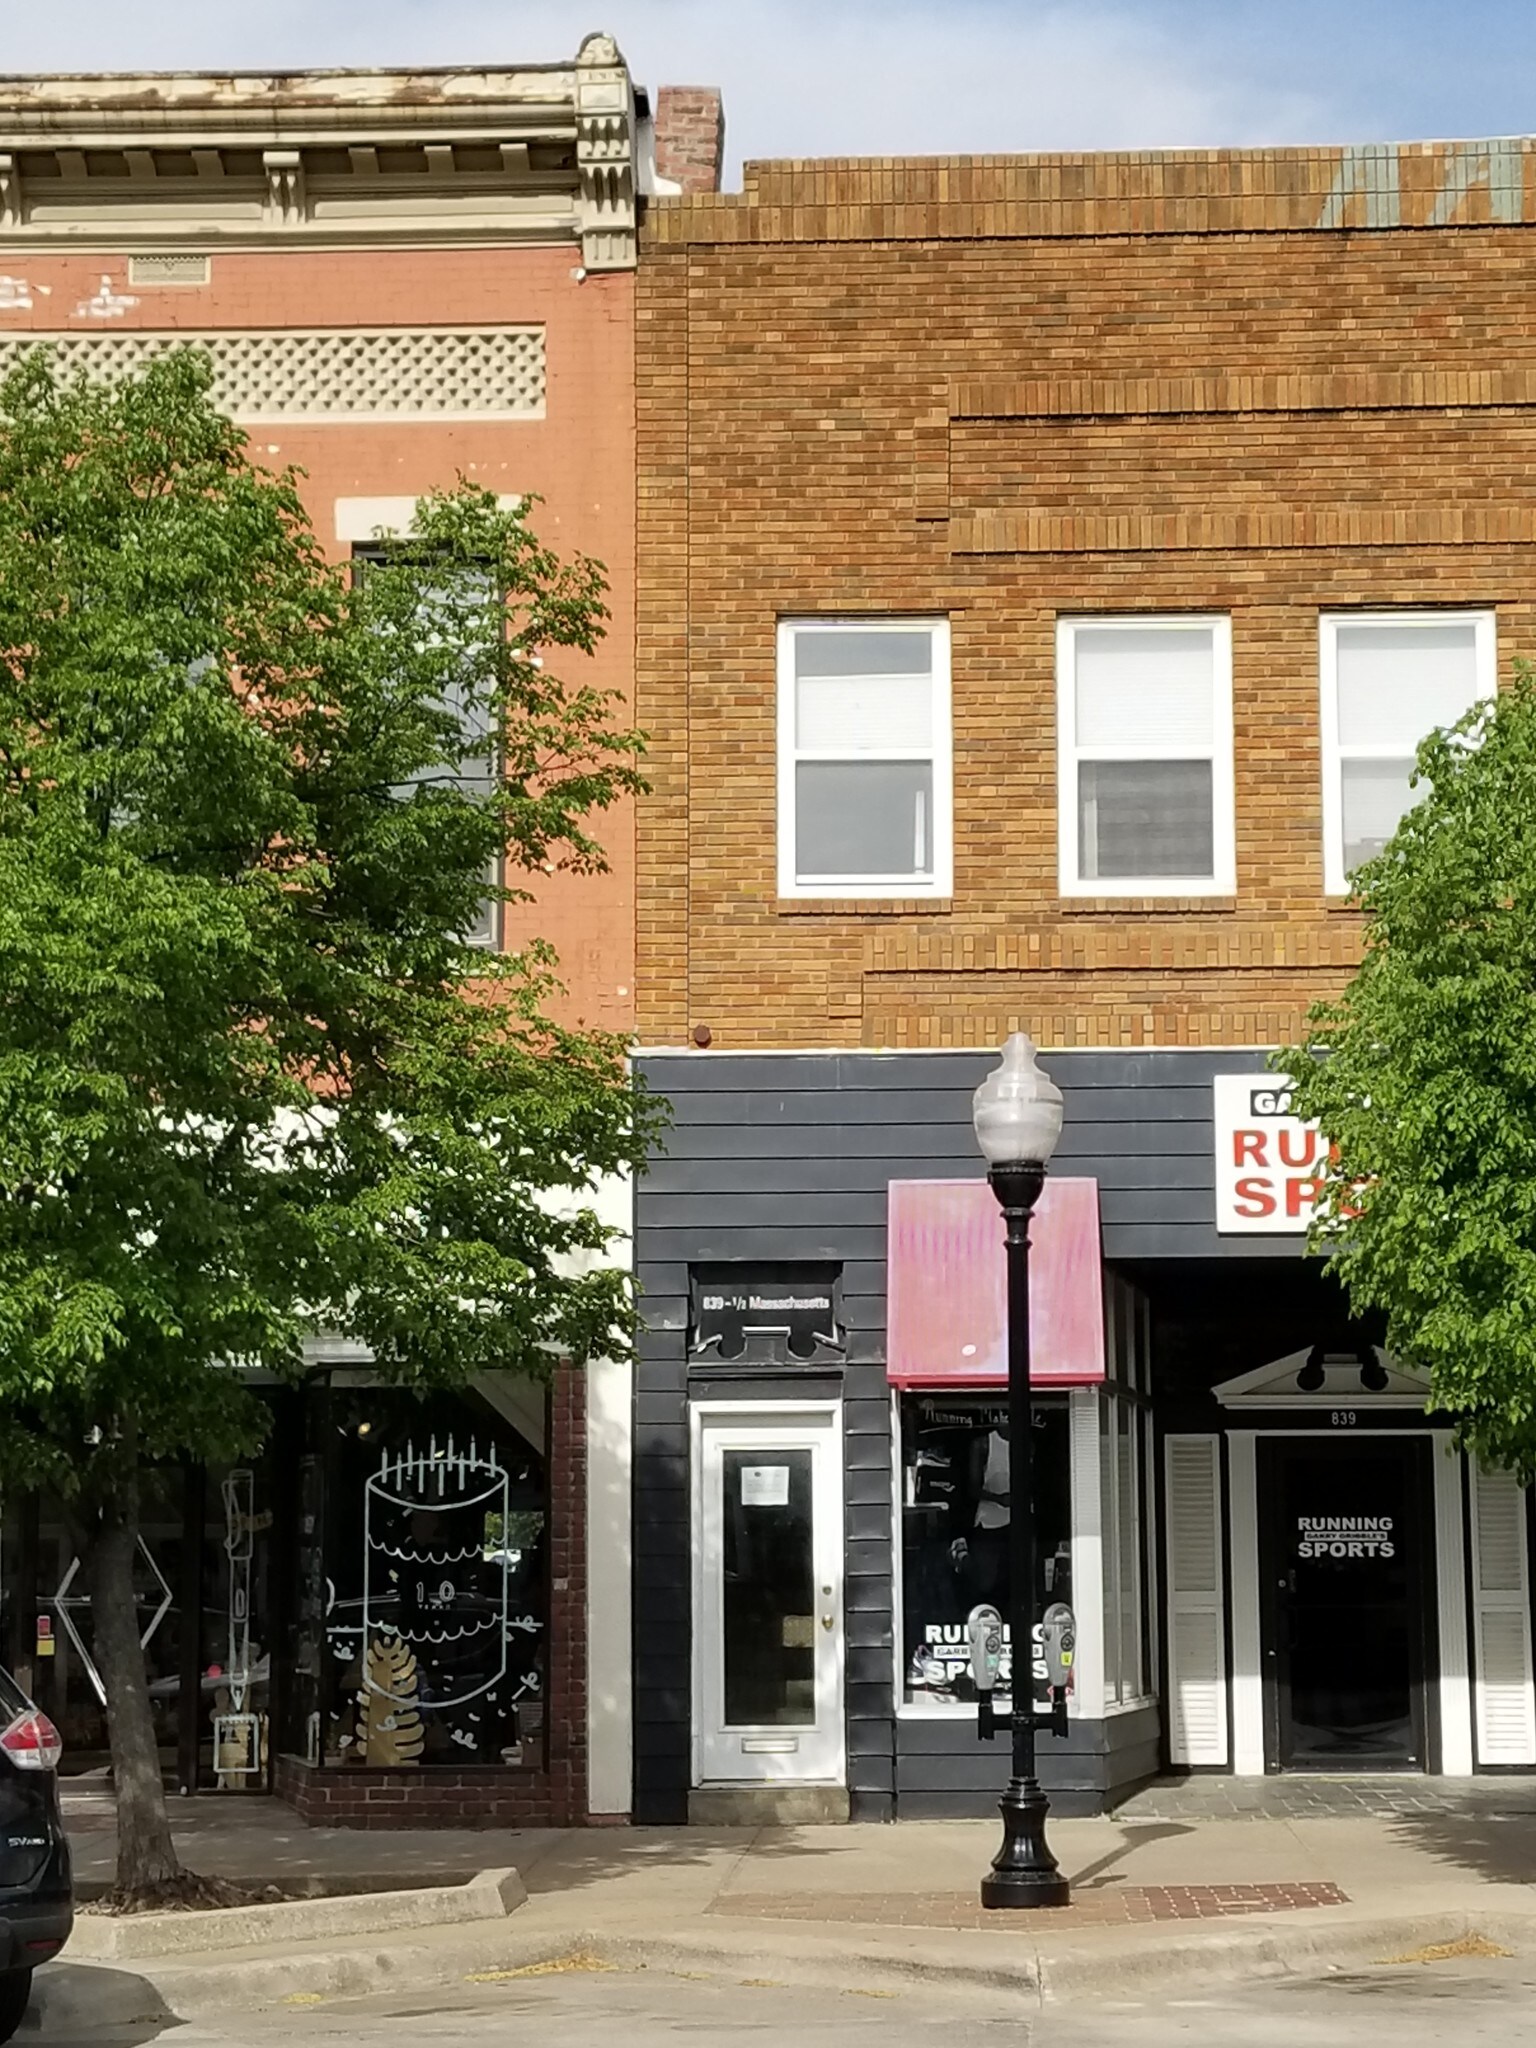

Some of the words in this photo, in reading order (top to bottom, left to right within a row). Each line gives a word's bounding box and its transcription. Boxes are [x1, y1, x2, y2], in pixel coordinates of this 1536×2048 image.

[1331, 1411, 1356, 1425] 839
[1298, 1517, 1393, 1531] RUNNING
[1298, 1542, 1395, 1558] SPORTS
